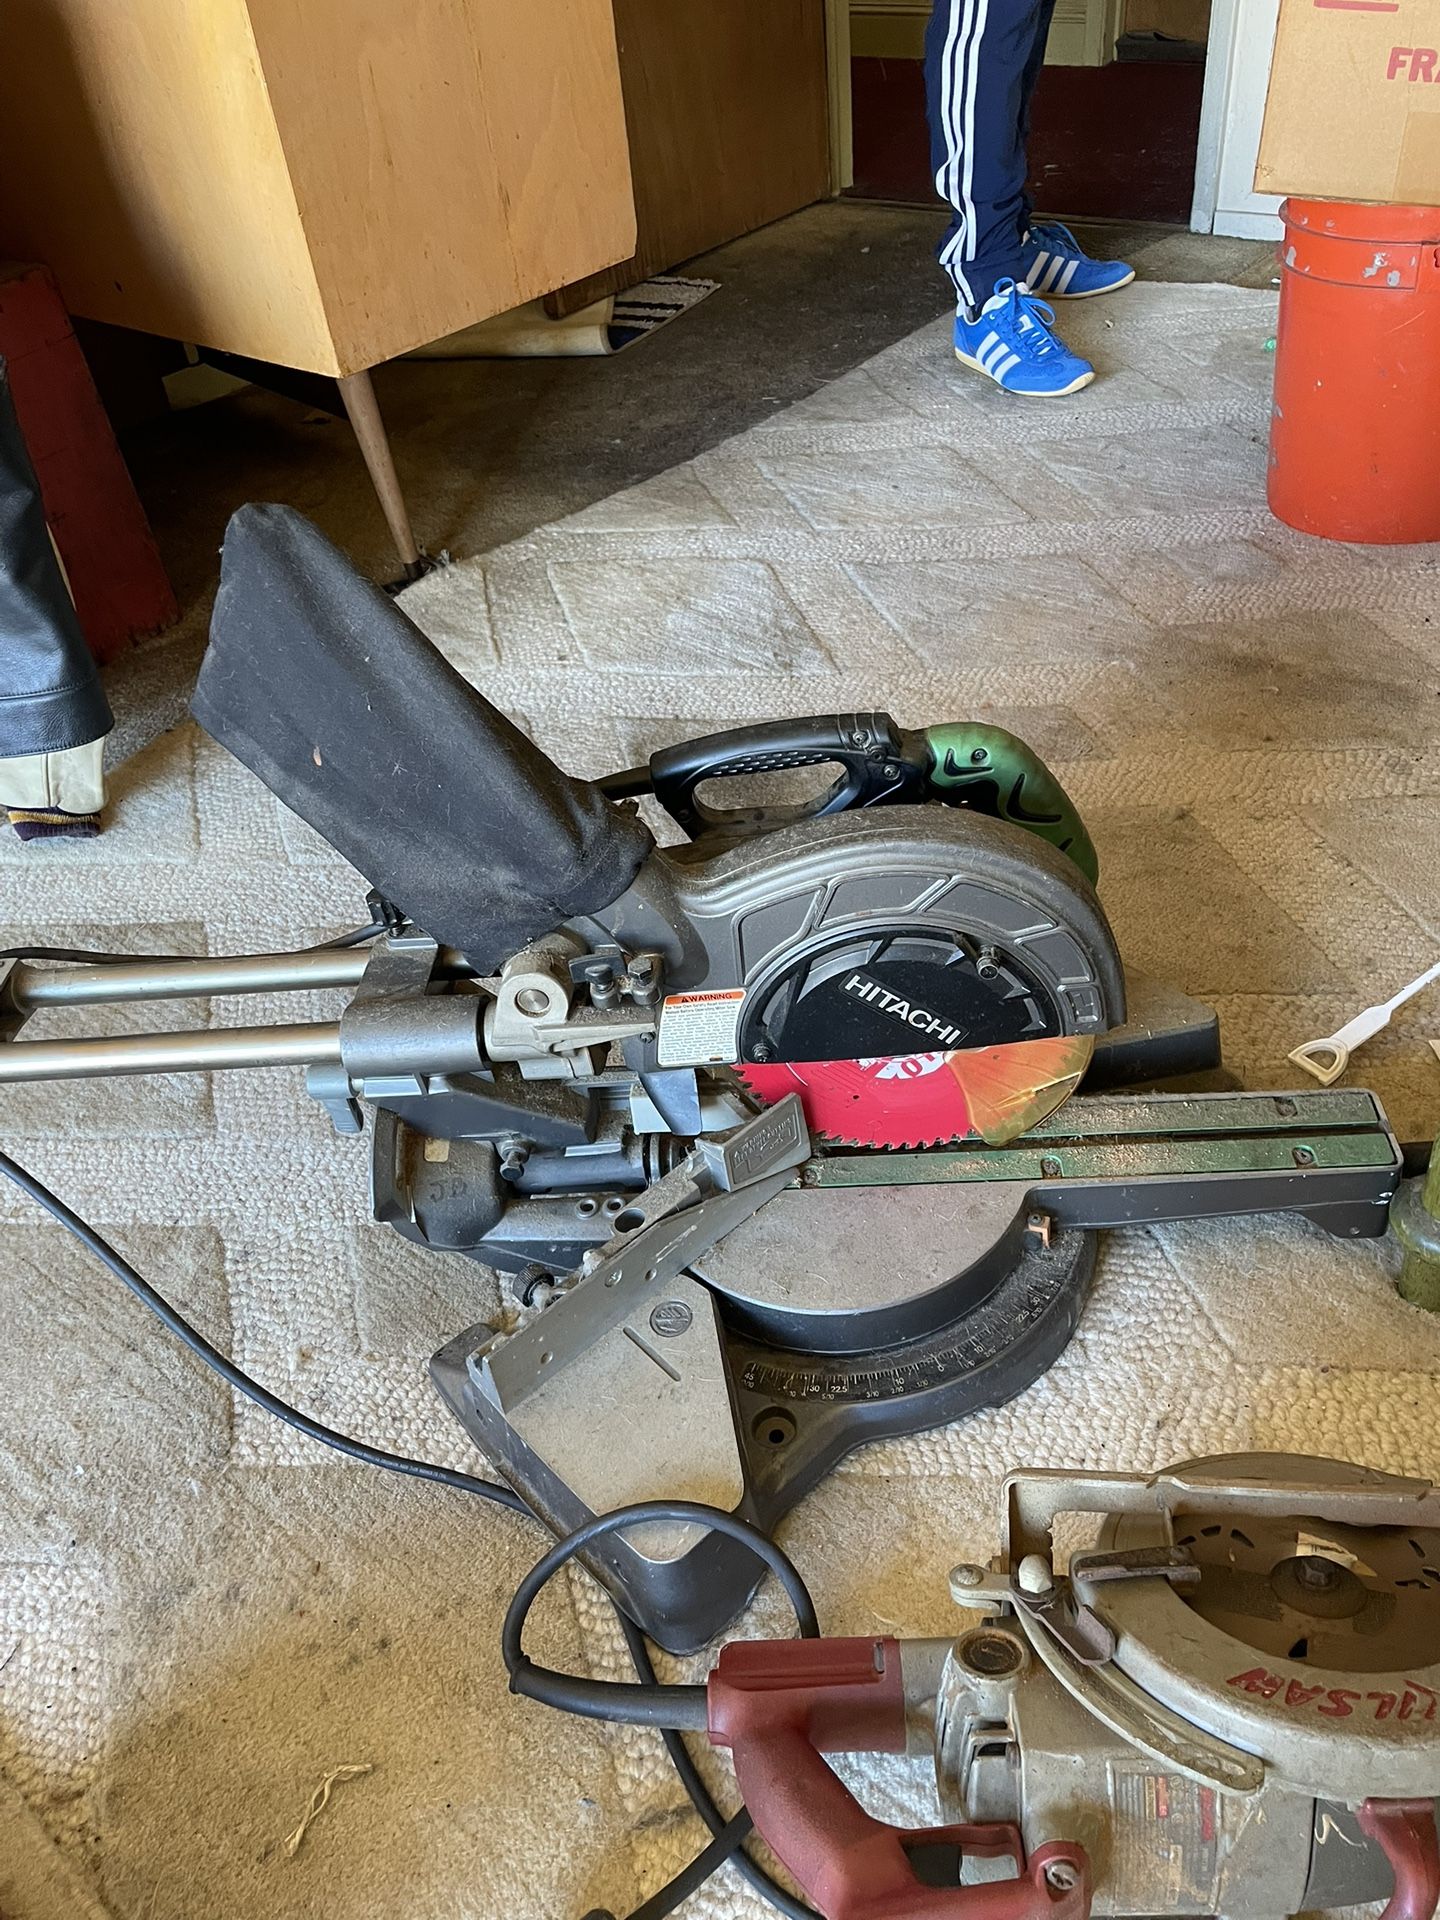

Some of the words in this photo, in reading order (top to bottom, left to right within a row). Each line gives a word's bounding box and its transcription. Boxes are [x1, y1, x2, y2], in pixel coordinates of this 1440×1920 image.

[1386, 46, 1440, 83] FR
[689, 993, 732, 1002] WARNING
[844, 974, 961, 1045] HITACHI
[744, 1372, 754, 1380] 45
[830, 1385, 848, 1393] 22.5
[895, 1377, 905, 1385] 10
[974, 1345, 983, 1354] 10
[1030, 1296, 1040, 1306] 30
[891, 1385, 904, 1394] 2/10
